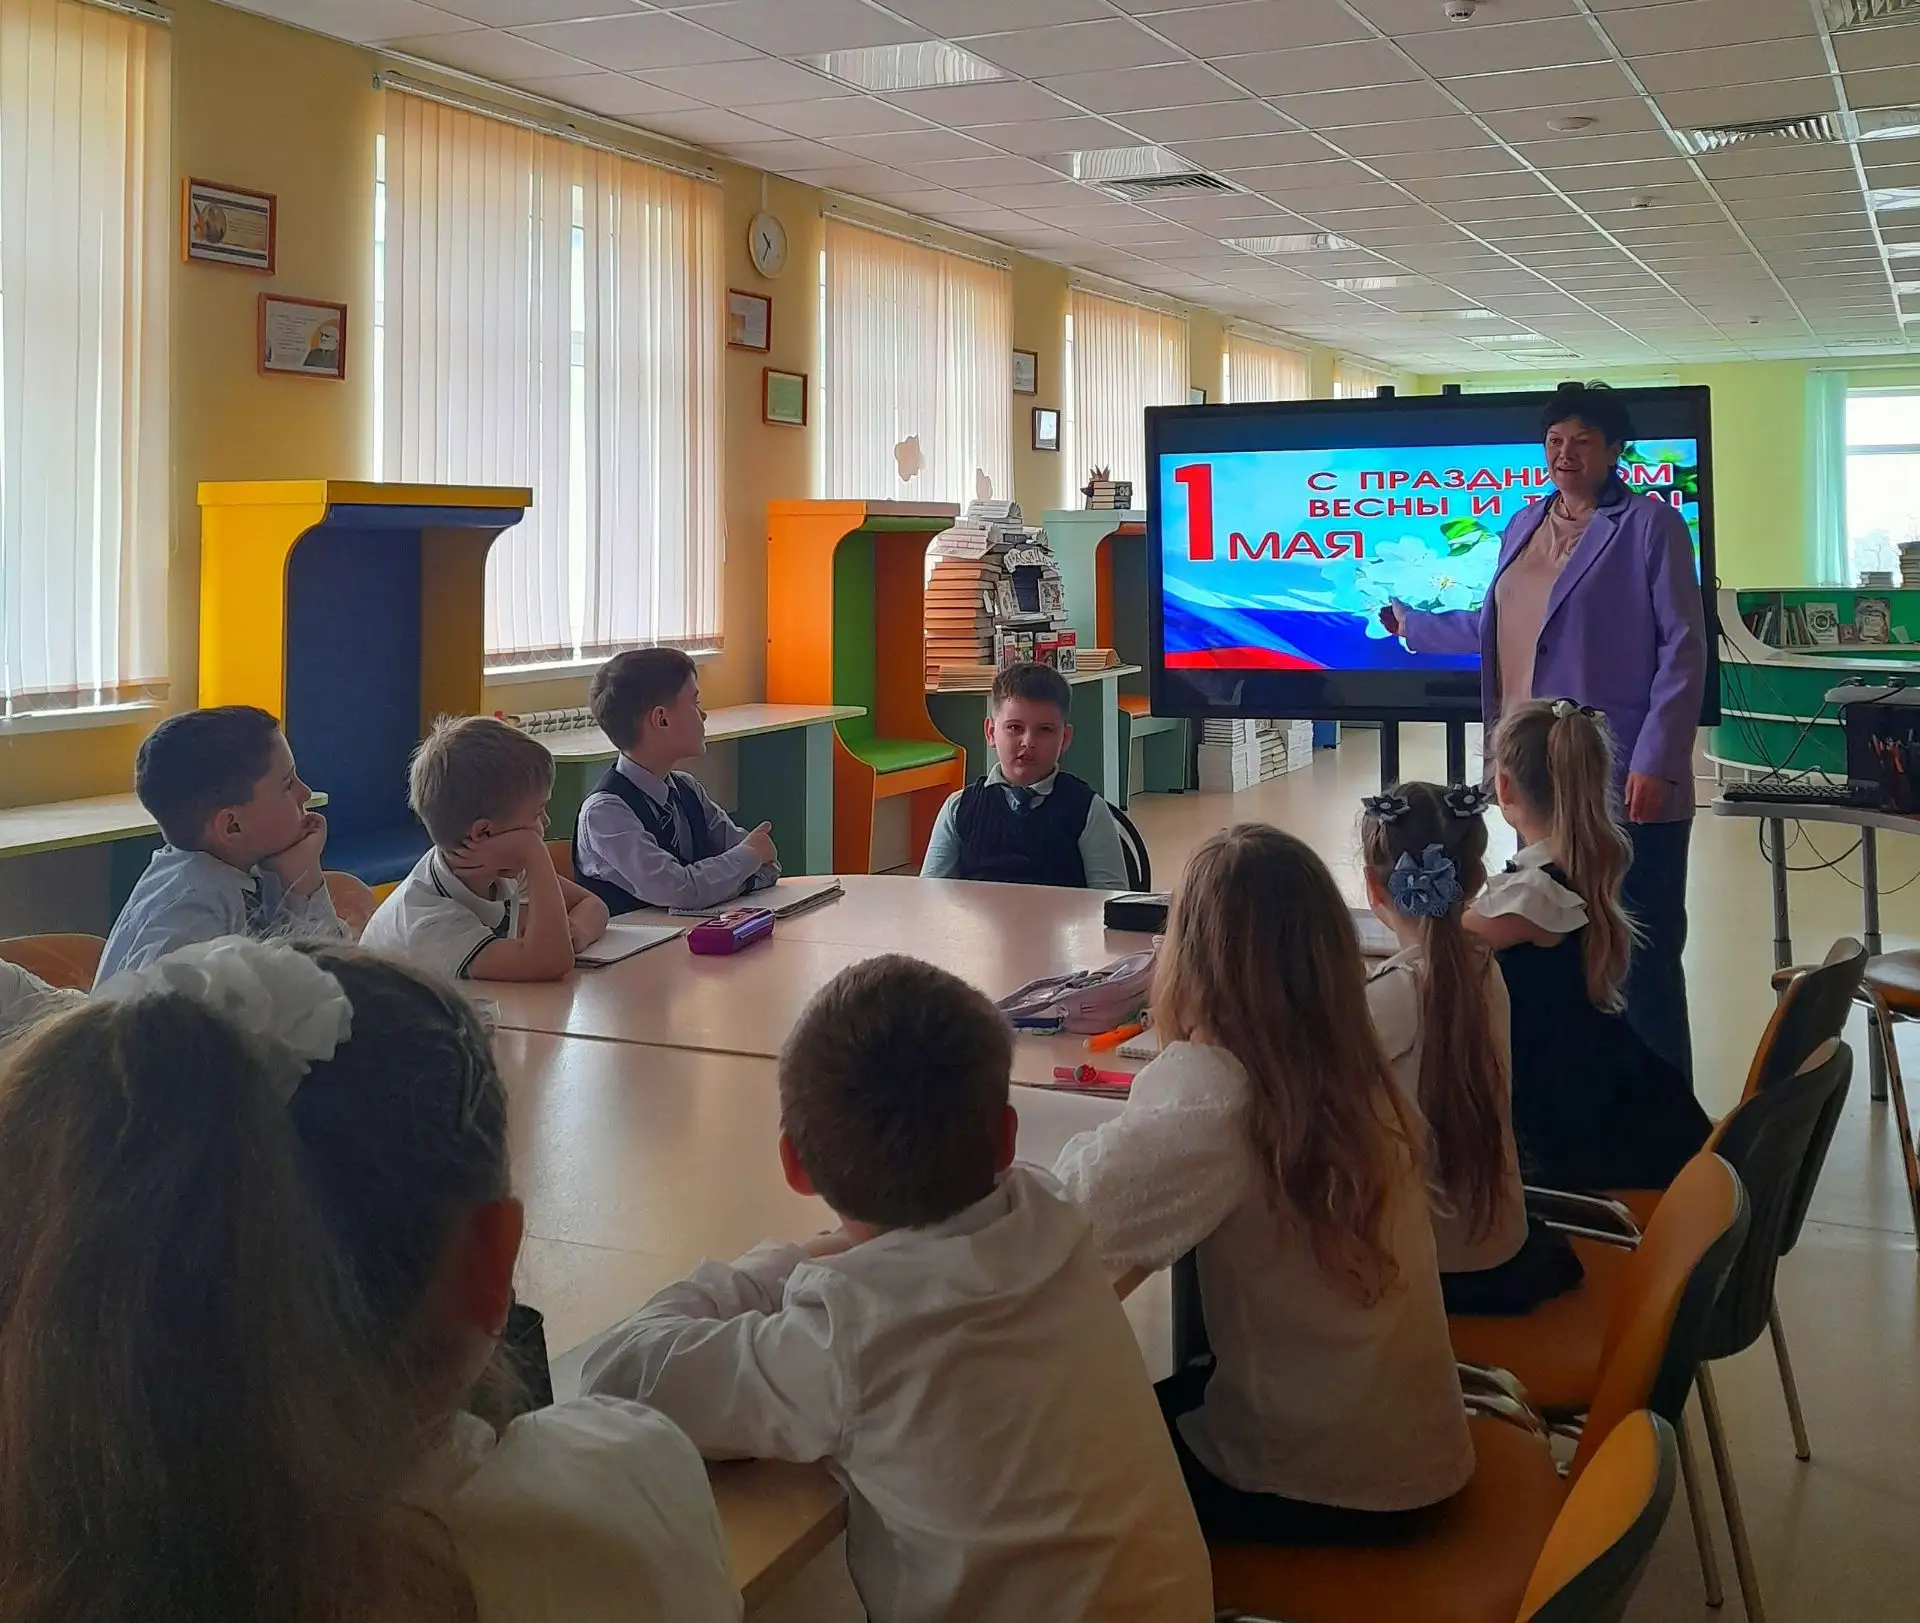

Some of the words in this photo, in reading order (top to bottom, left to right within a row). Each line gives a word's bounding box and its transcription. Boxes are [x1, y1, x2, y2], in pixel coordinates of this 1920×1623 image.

[1307, 472, 1338, 491] С
[1174, 463, 1214, 560] 1
[1229, 530, 1364, 560] МАЯ
[1309, 496, 1448, 518] ВЕСНЫ
[1472, 496, 1500, 516] И
